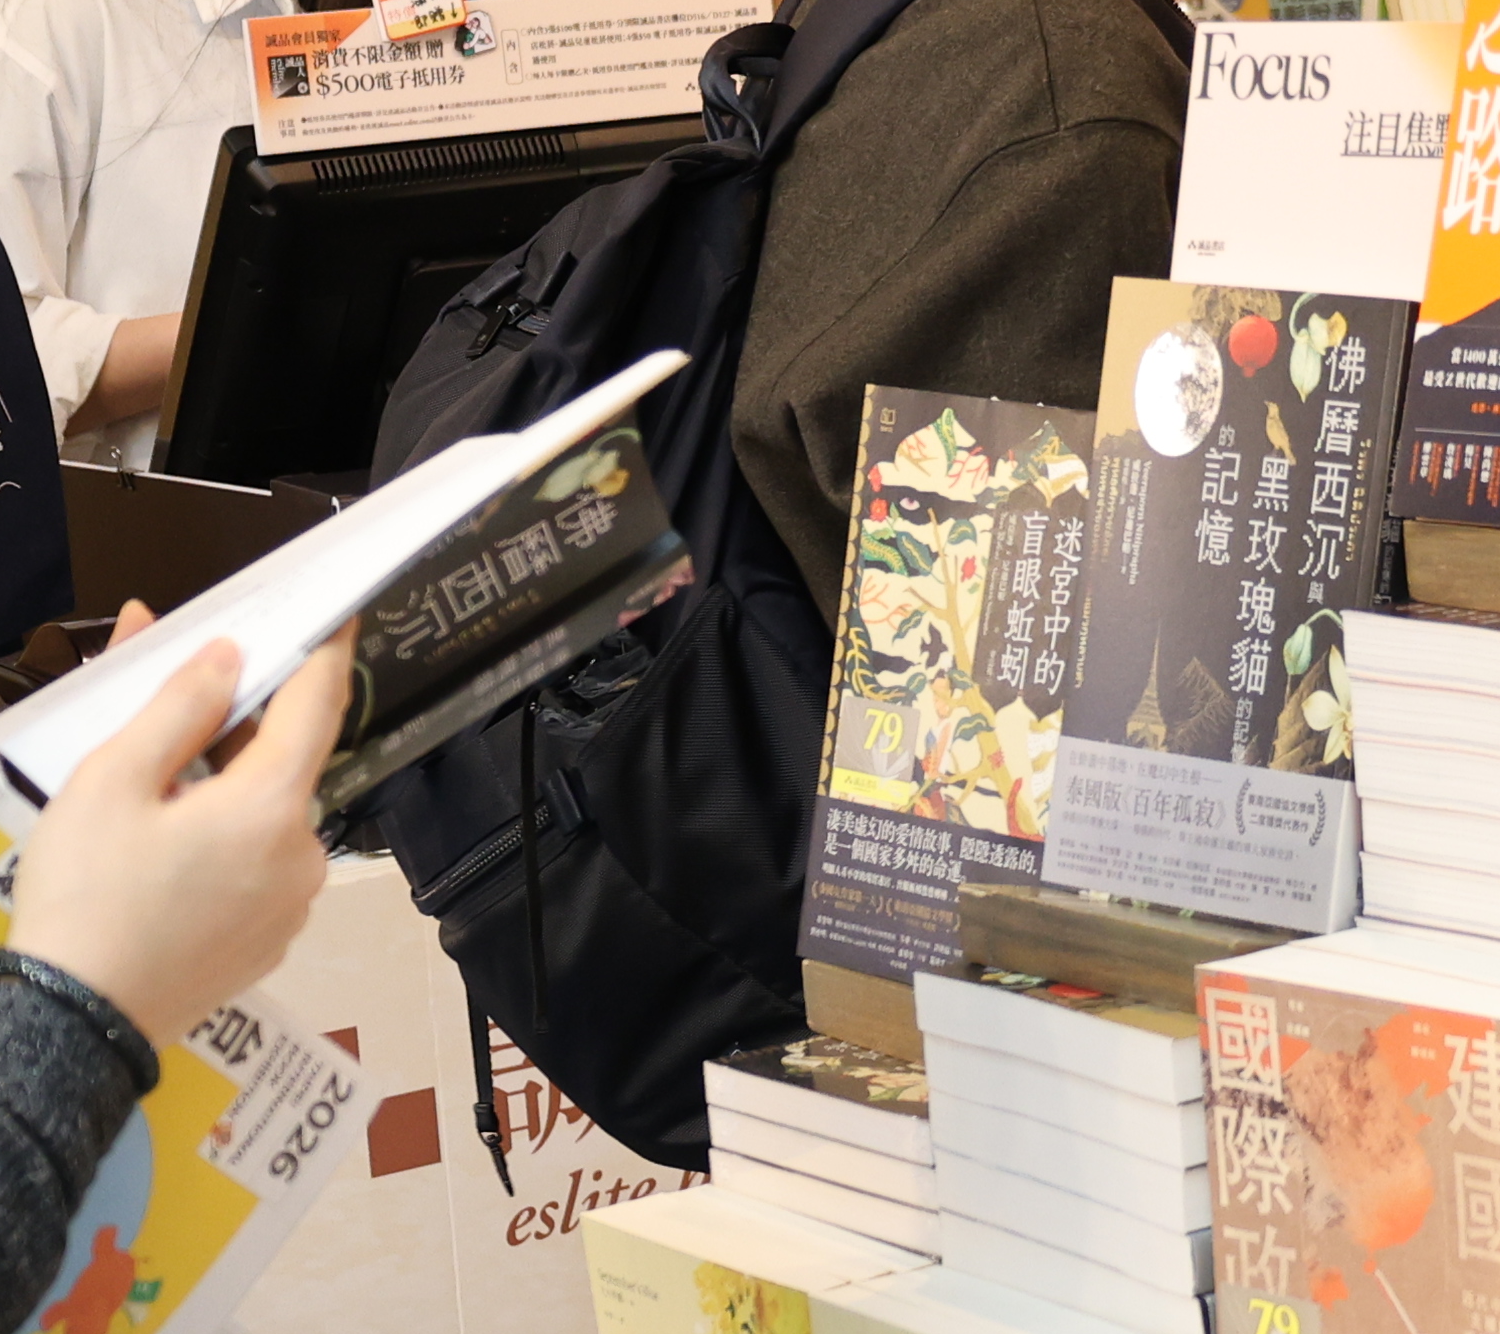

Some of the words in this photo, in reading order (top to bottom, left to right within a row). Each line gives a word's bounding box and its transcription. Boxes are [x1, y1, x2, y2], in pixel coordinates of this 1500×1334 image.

[265, 29, 341, 48] 誠品會員獨家
[315, 65, 465, 99] $500電子抵用券
[1195, 32, 1331, 103] Focus
[1194, 423, 1242, 568] 的記憶
[1299, 336, 1369, 607] 佛曆西沉與
[996, 510, 1050, 691] 盲眼蚯蚓
[1034, 517, 1084, 696] 迷宮中的
[862, 708, 905, 755] 79
[1065, 775, 1227, 830] 泰國版《百年孤寂》
[266, 1071, 356, 1182] 2026
